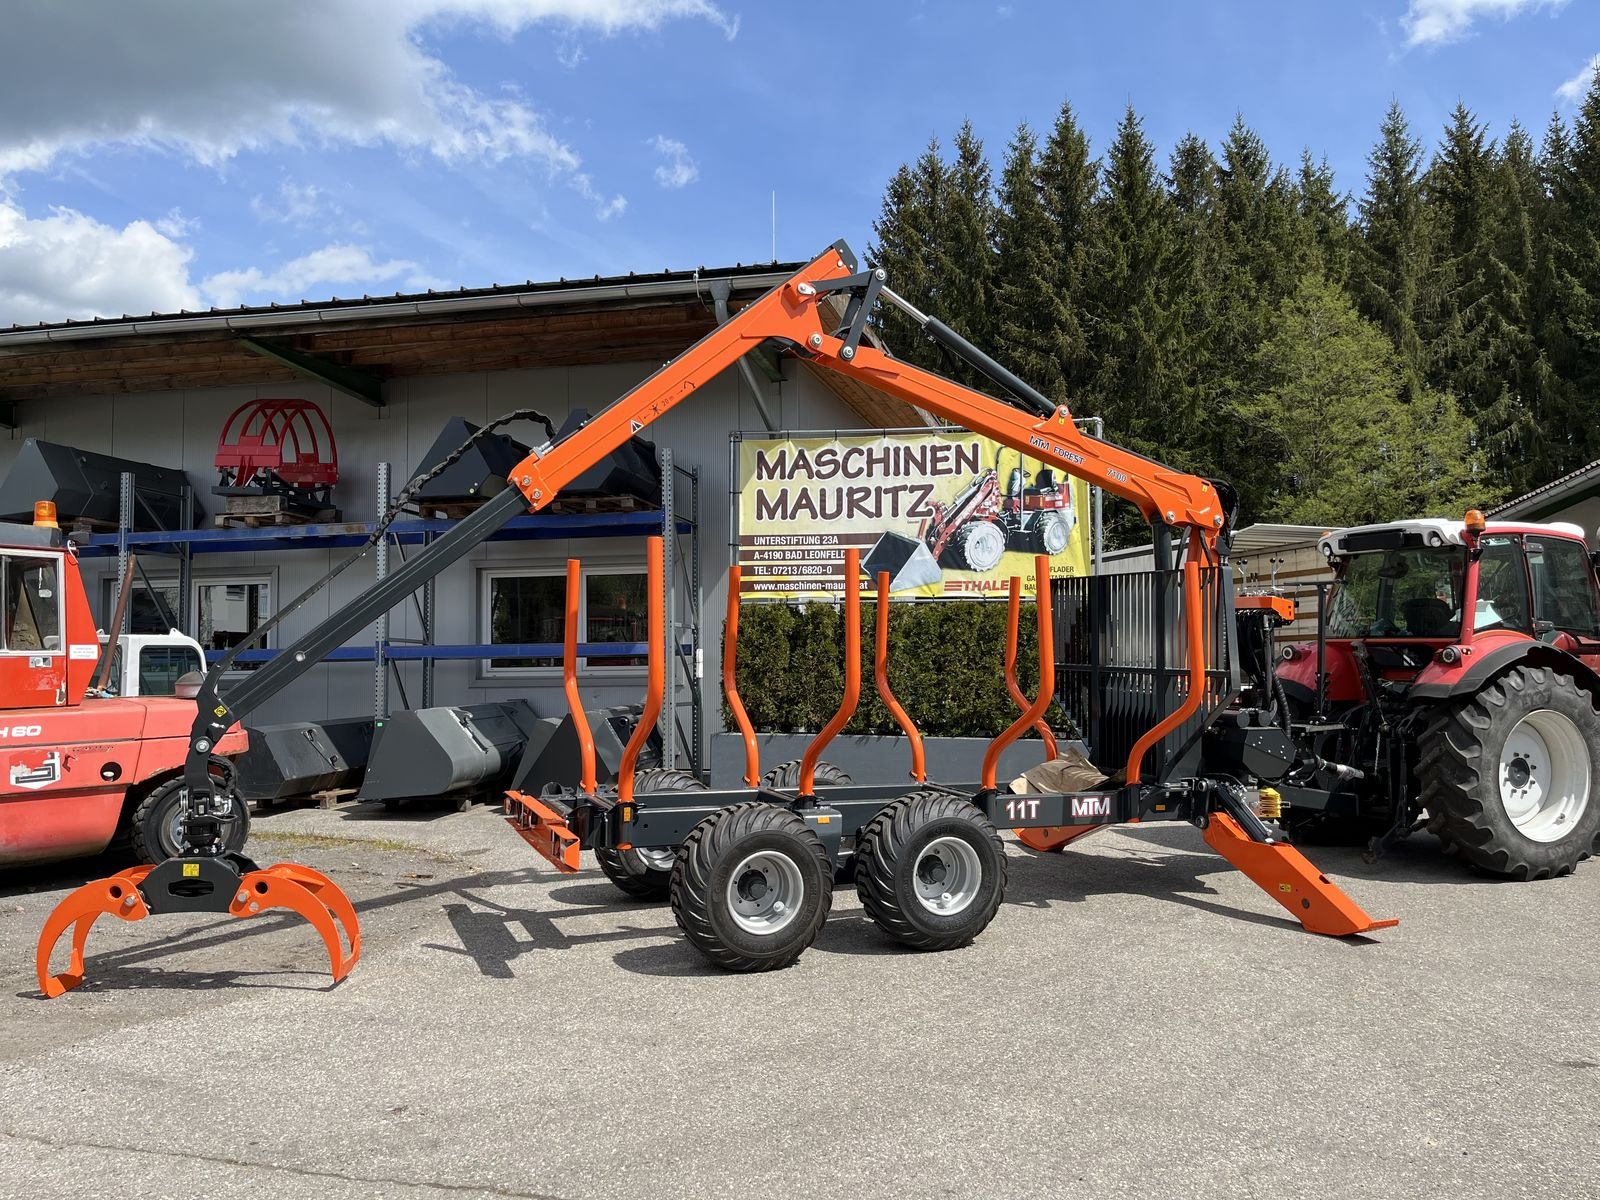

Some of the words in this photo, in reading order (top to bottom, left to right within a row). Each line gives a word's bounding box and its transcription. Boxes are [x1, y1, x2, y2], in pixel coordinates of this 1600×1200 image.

[1029, 435, 1050, 451] MTM
[1053, 446, 1085, 465] FOREST
[755, 442, 980, 481] MASCHINEN
[1106, 468, 1128, 483] 7100
[755, 483, 935, 521] MAURITZ
[753, 536, 821, 546] UNTERSTIFTUNG
[822, 535, 839, 545] 23A
[753, 551, 783, 560] A-4190
[785, 550, 803, 560] BAD
[804, 549, 846, 560] LEONFELD
[753, 566, 771, 575] TEL:
[961, 579, 1010, 592] THALE
[1006, 799, 1041, 820] 11T
[1070, 796, 1112, 818] MTM
